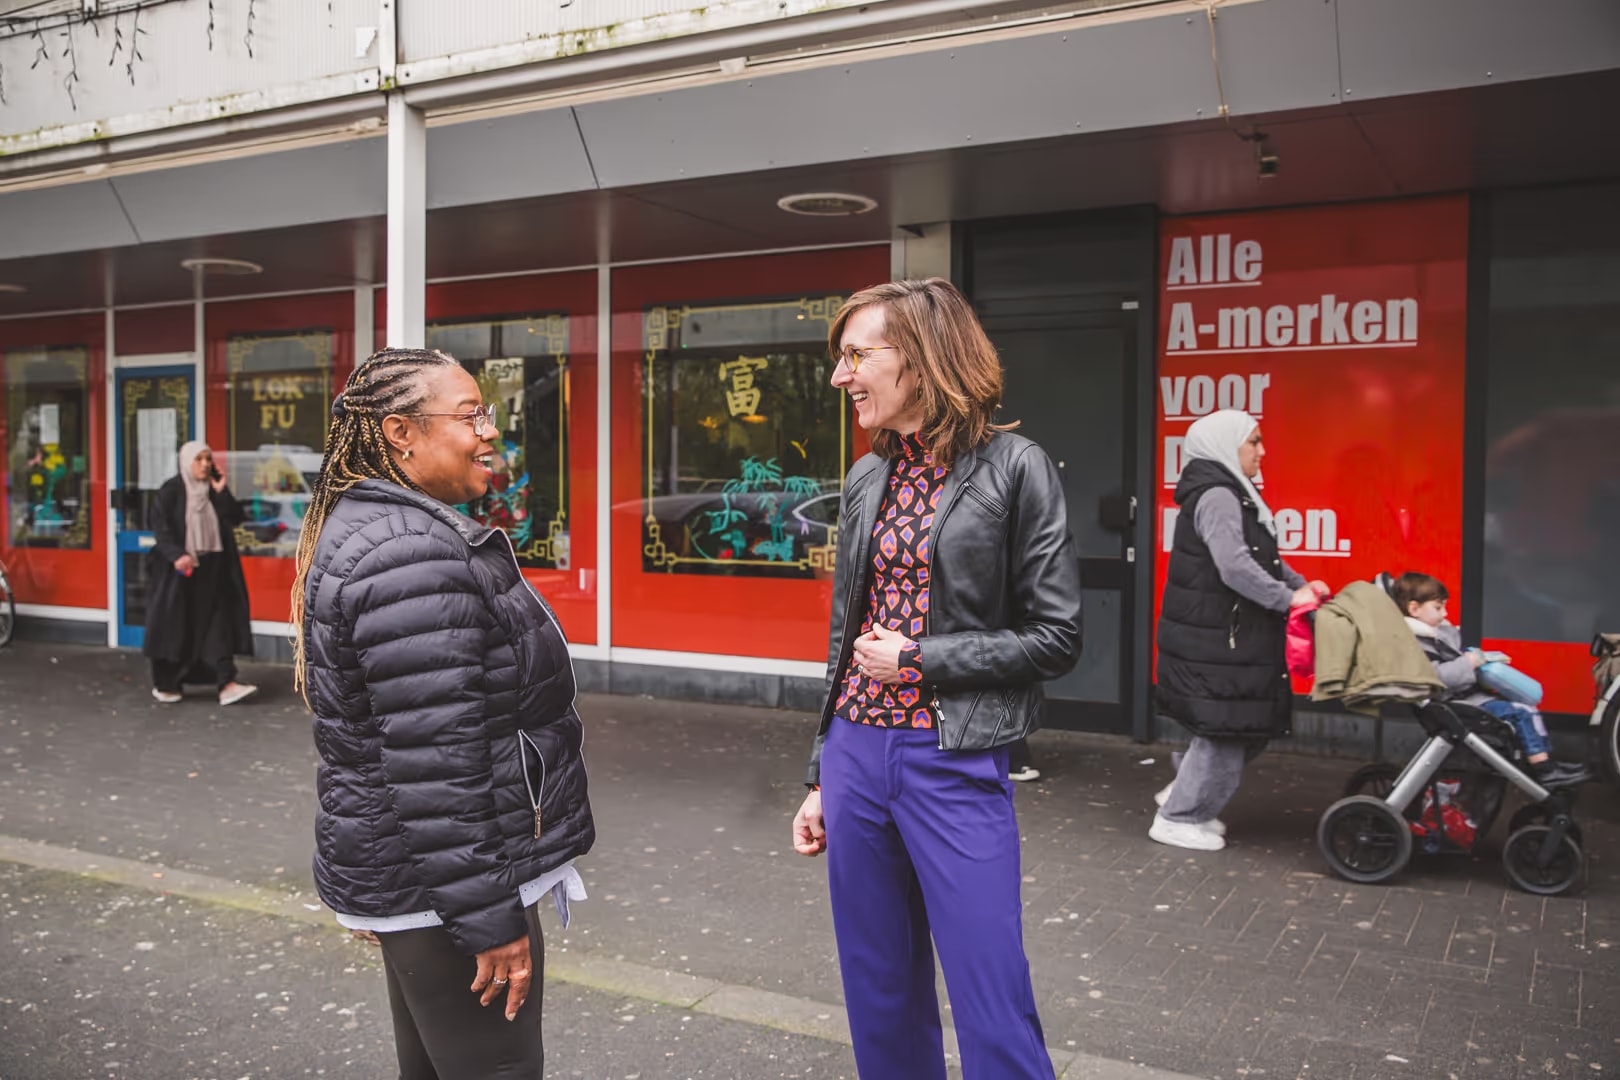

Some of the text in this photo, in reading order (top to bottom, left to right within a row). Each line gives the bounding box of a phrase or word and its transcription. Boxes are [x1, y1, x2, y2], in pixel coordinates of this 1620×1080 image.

[1167, 233, 1262, 285] Alle
[1166, 294, 1418, 350] A-merken
[253, 377, 304, 401] LOK
[719, 355, 768, 416] 富
[1160, 373, 1270, 415] voor
[260, 404, 296, 429] FU
